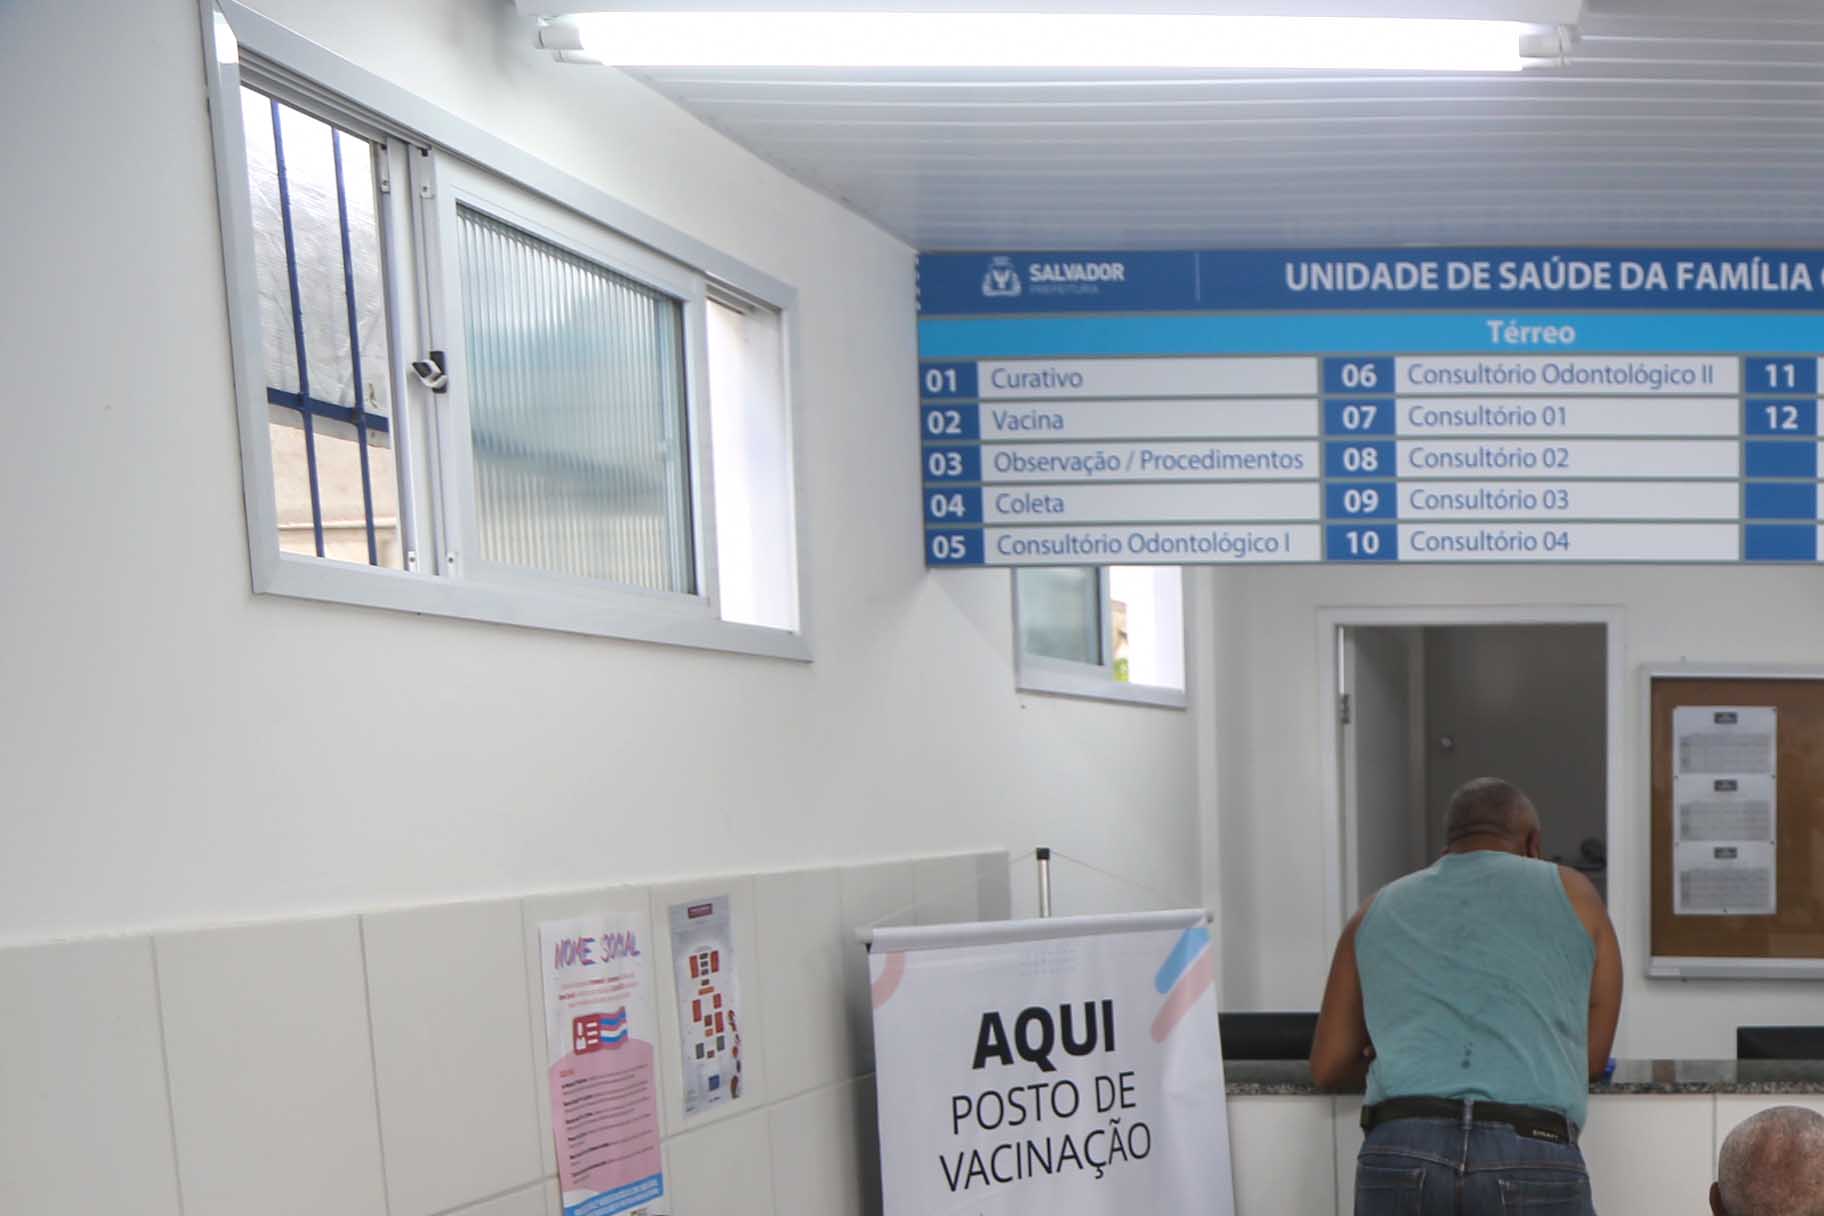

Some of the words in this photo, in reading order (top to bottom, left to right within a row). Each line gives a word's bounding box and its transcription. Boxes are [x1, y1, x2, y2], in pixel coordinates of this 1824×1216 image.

[1028, 262, 1126, 282] SALVADOR
[1284, 262, 1440, 291] UNIDADE
[1447, 262, 1491, 291] DE
[1499, 256, 1612, 291] SAÚDE
[1620, 262, 1669, 291] DA
[1676, 257, 1813, 291] FAMÍLIA
[1487, 319, 1576, 344] Térreo
[925, 369, 957, 392] 01
[991, 368, 1083, 388] Curativo
[1341, 363, 1377, 387] 06
[1408, 363, 1536, 385] Consultório
[1542, 363, 1696, 389] Odontológico
[1702, 365, 1714, 384] II
[1765, 364, 1796, 388] 11
[928, 411, 962, 434] 02
[992, 409, 1064, 431] Vacina
[1342, 406, 1377, 429] 07
[1408, 406, 1536, 427] Consultório
[1542, 406, 1567, 426] 01
[1765, 405, 1799, 430] 12
[928, 452, 963, 476] 03
[994, 450, 1120, 476] Observação
[1125, 451, 1135, 472] /
[1140, 449, 1304, 471] Procedimentos
[1343, 447, 1378, 471] 08
[1409, 447, 1536, 469] Consultório
[1542, 448, 1569, 468] 02
[930, 494, 965, 517] 04
[995, 493, 1064, 514] Coleta
[1343, 489, 1379, 513] 09
[1410, 488, 1537, 510] Consultório
[1542, 489, 1569, 510] 03
[932, 535, 967, 559] 05
[997, 533, 1122, 556] Consultório
[1128, 532, 1279, 557] Odontológico
[1346, 531, 1380, 554] 10
[1410, 530, 1537, 551] Consultório
[1543, 531, 1570, 551] 04
[972, 999, 1116, 1072] AQUI
[952, 1079, 1079, 1135] POSTO
[1095, 1071, 1136, 1113] DE
[939, 1118, 1151, 1192] VACINAÇÃO
